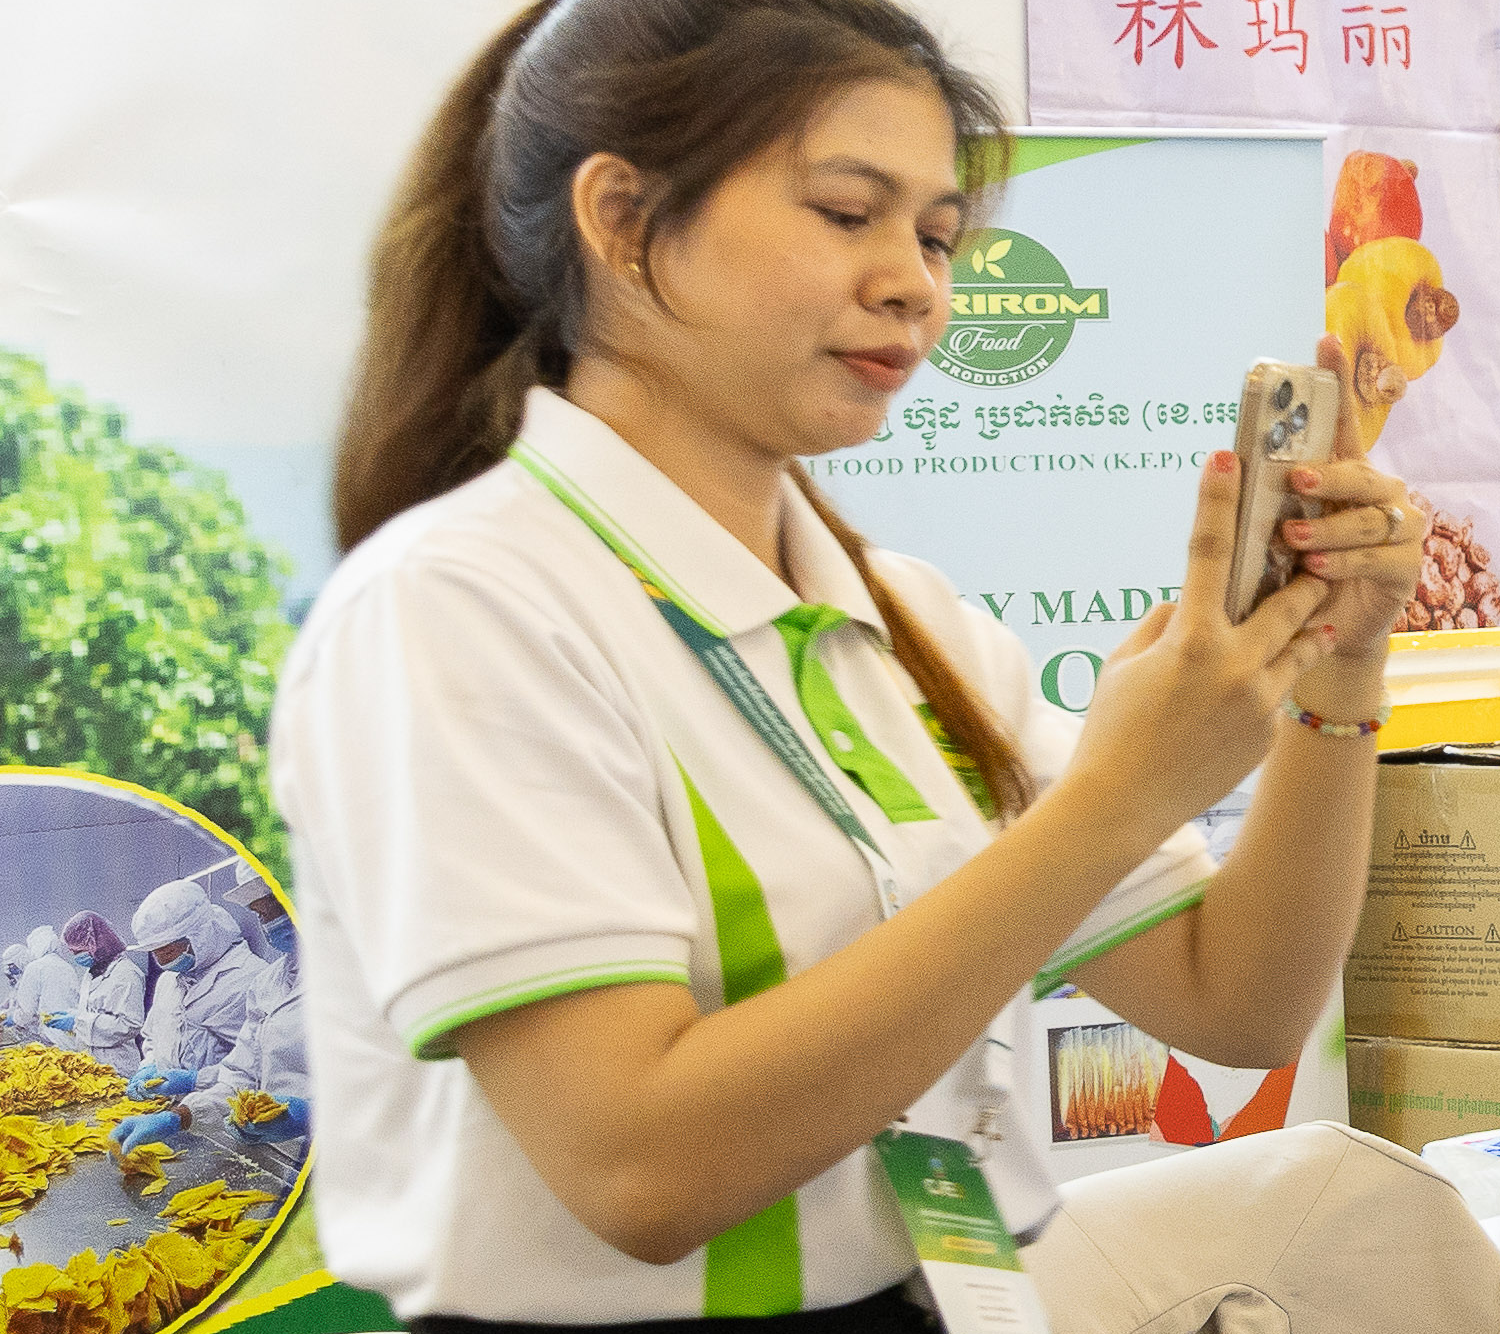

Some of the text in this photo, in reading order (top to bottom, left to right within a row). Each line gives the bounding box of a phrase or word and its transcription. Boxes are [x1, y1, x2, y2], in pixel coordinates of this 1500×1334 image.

[950, 293, 1100, 315] RIROM
[950, 323, 1047, 361] Food
[939, 357, 1050, 385] PRODUCTION
[828, 457, 903, 478] FOOD
[915, 453, 1095, 475] PRODUCTION
[1103, 452, 1183, 473] (K.F.P)
[1415, 924, 1476, 937] CAUTION
